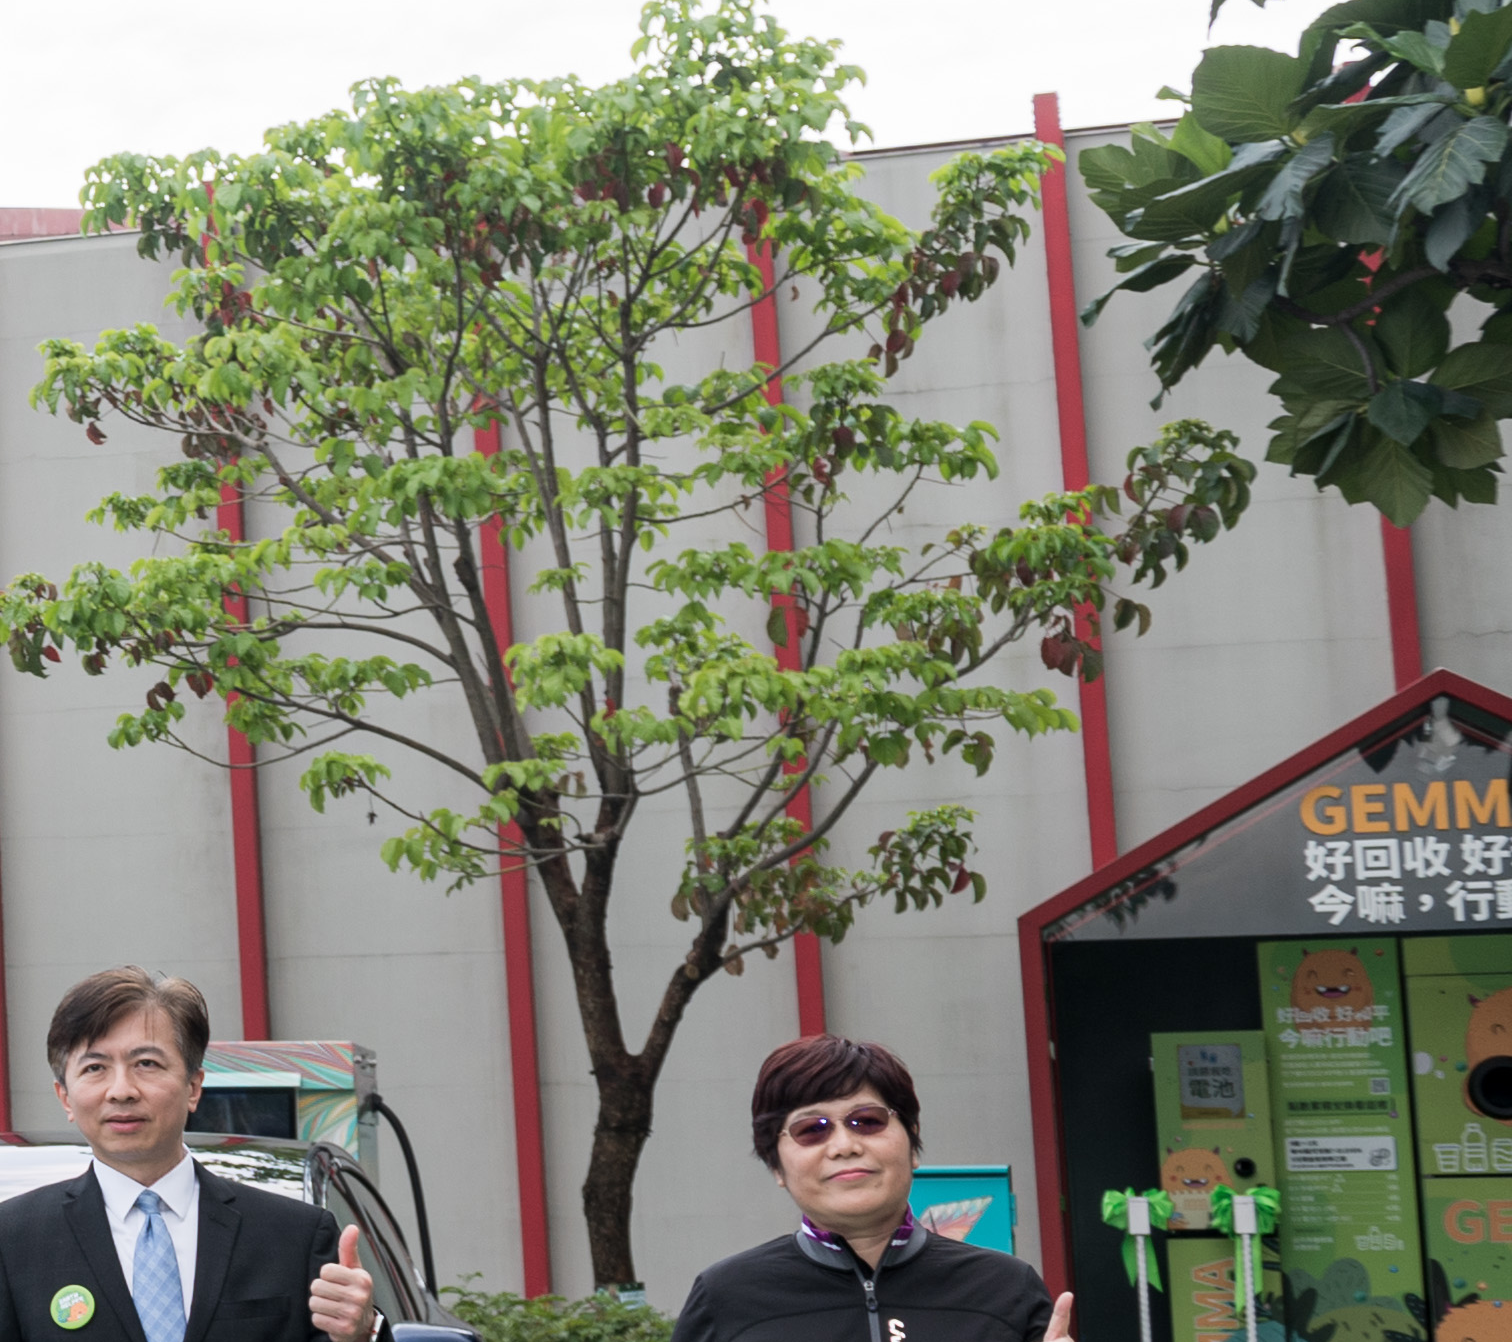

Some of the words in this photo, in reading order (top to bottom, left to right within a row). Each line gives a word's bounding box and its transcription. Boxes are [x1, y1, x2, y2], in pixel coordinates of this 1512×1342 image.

[1299, 778, 1512, 836] GEMM
[1304, 839, 1452, 881] 好回收
[1460, 834, 1512, 875] 好
[1189, 1078, 1236, 1099] 電池
